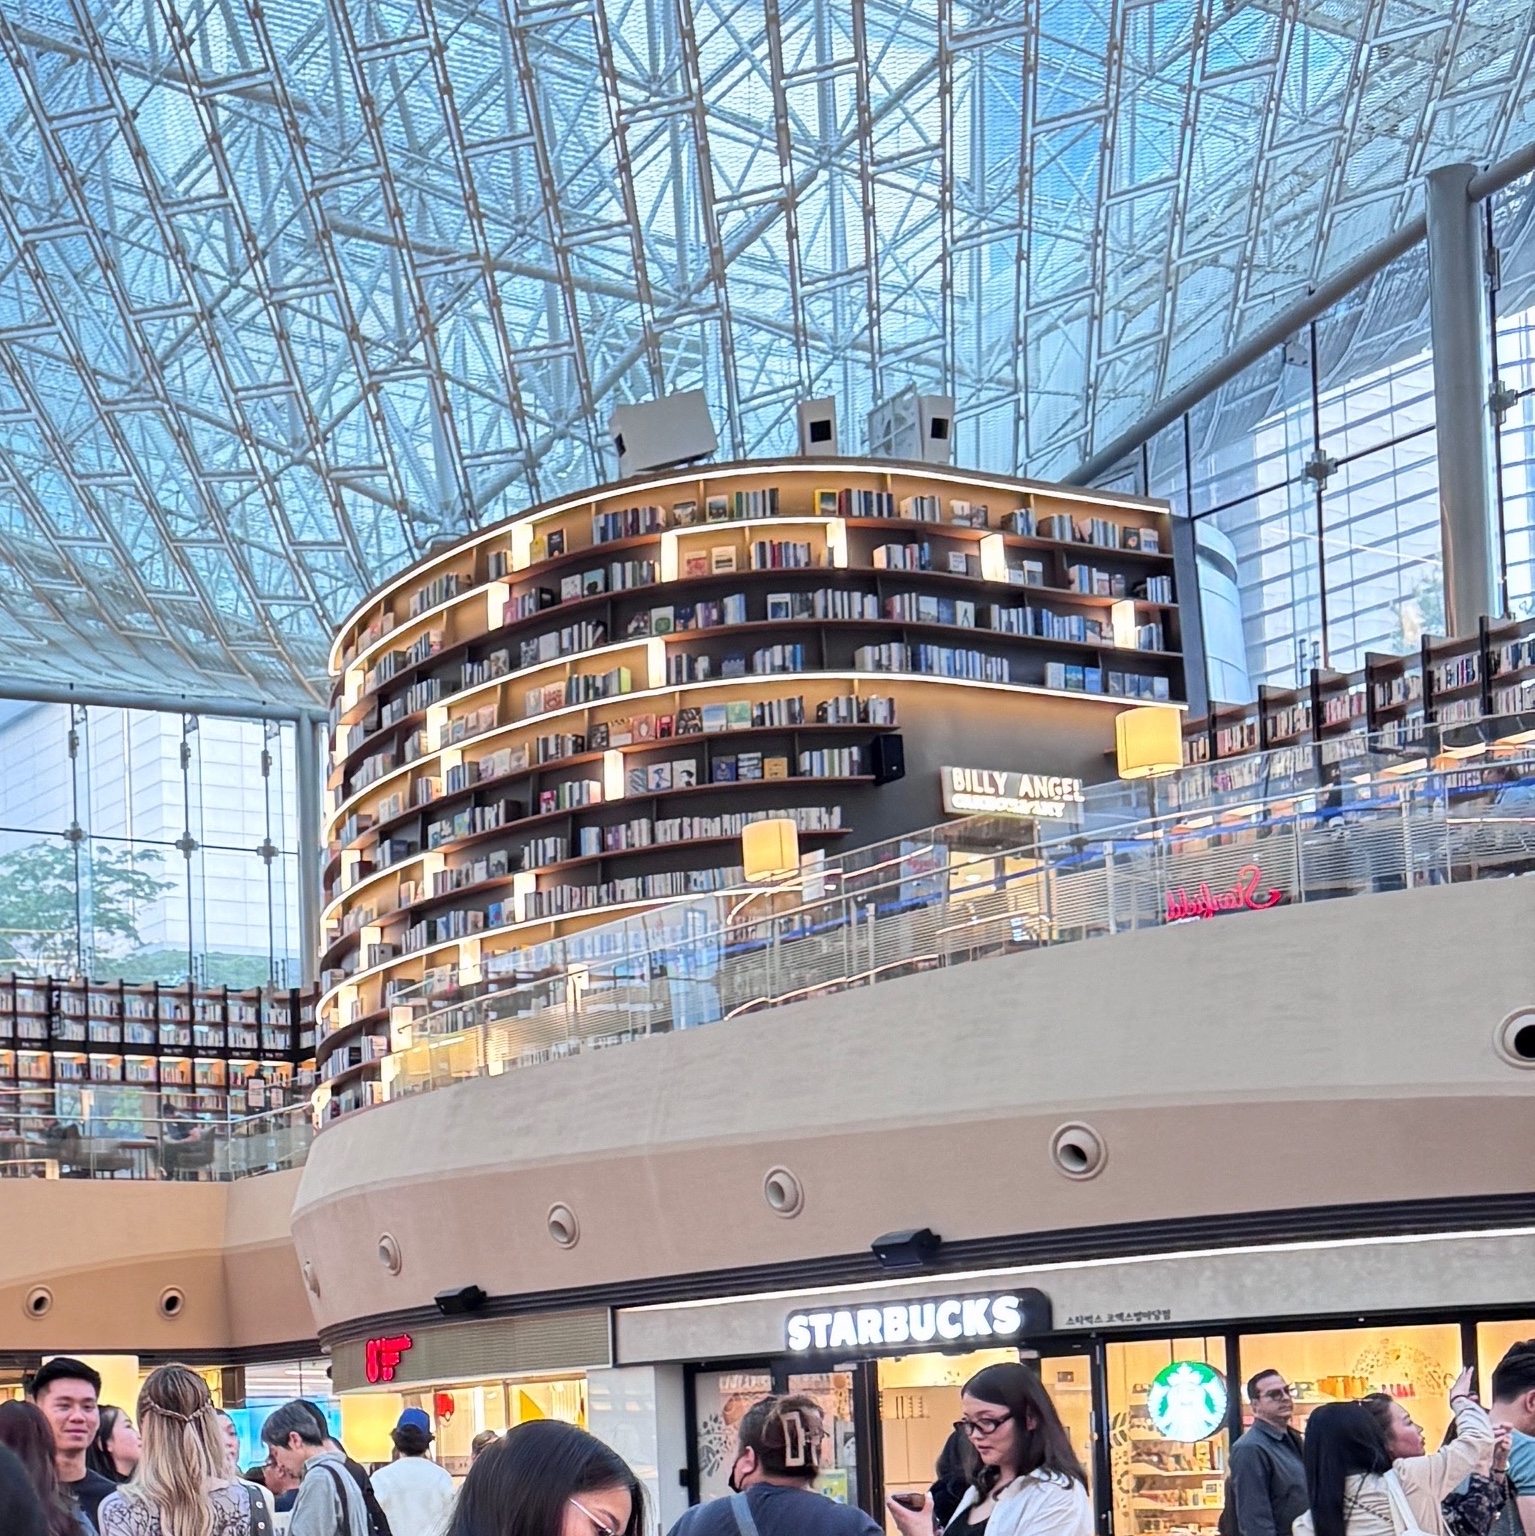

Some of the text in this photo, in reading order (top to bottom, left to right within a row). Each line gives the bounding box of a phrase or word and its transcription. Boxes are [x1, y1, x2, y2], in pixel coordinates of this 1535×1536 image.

[952, 767, 1085, 802] BILLY ANGEL
[787, 1295, 1022, 1351] STARBUCKS
